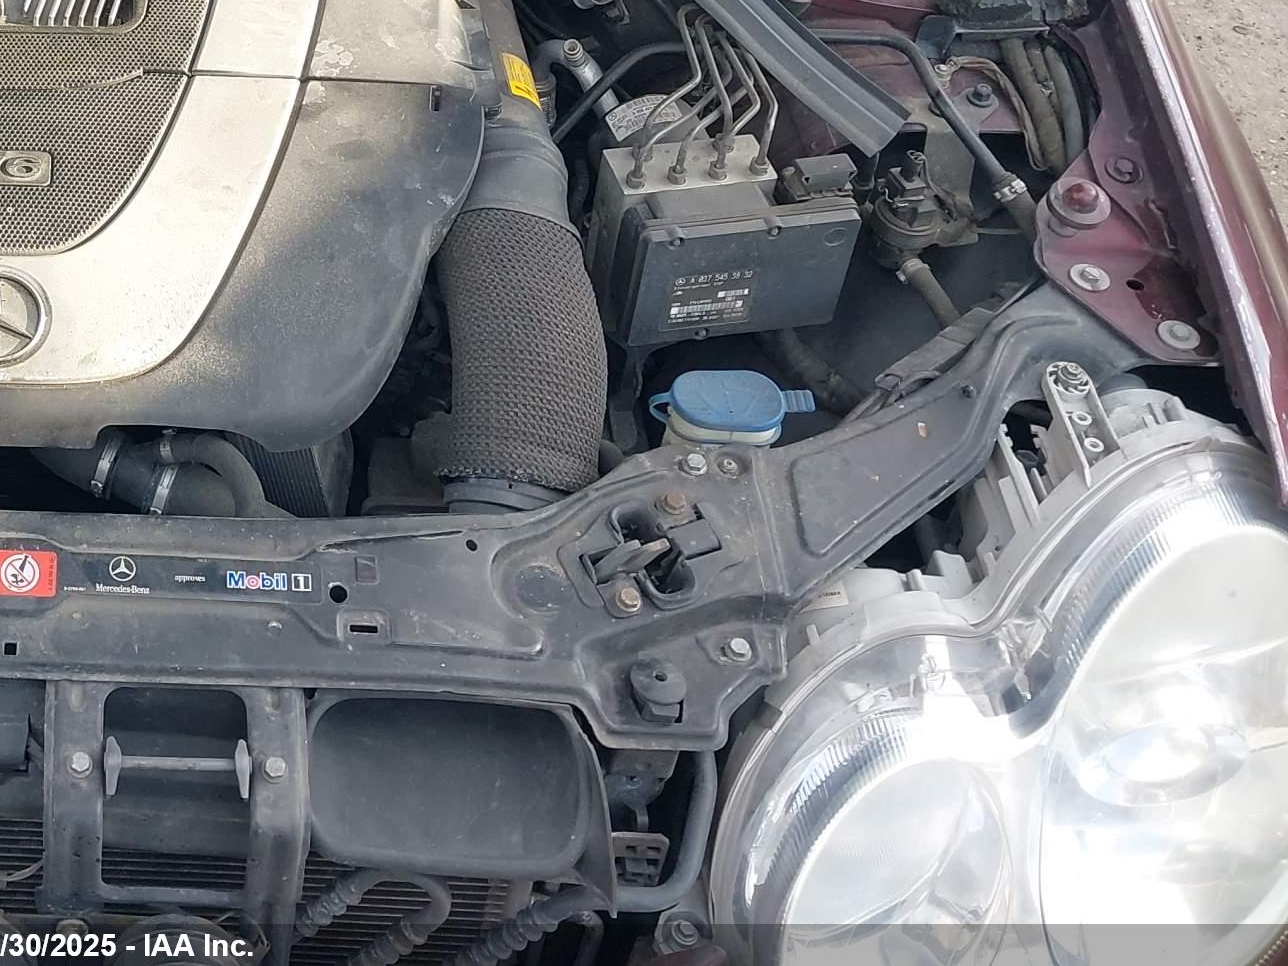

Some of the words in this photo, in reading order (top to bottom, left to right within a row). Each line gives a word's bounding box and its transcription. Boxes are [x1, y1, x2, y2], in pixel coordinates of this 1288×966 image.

[174, 575, 206, 583] approves
[226, 570, 288, 591] Mobil
[96, 583, 150, 594] Mercedes-Benz
